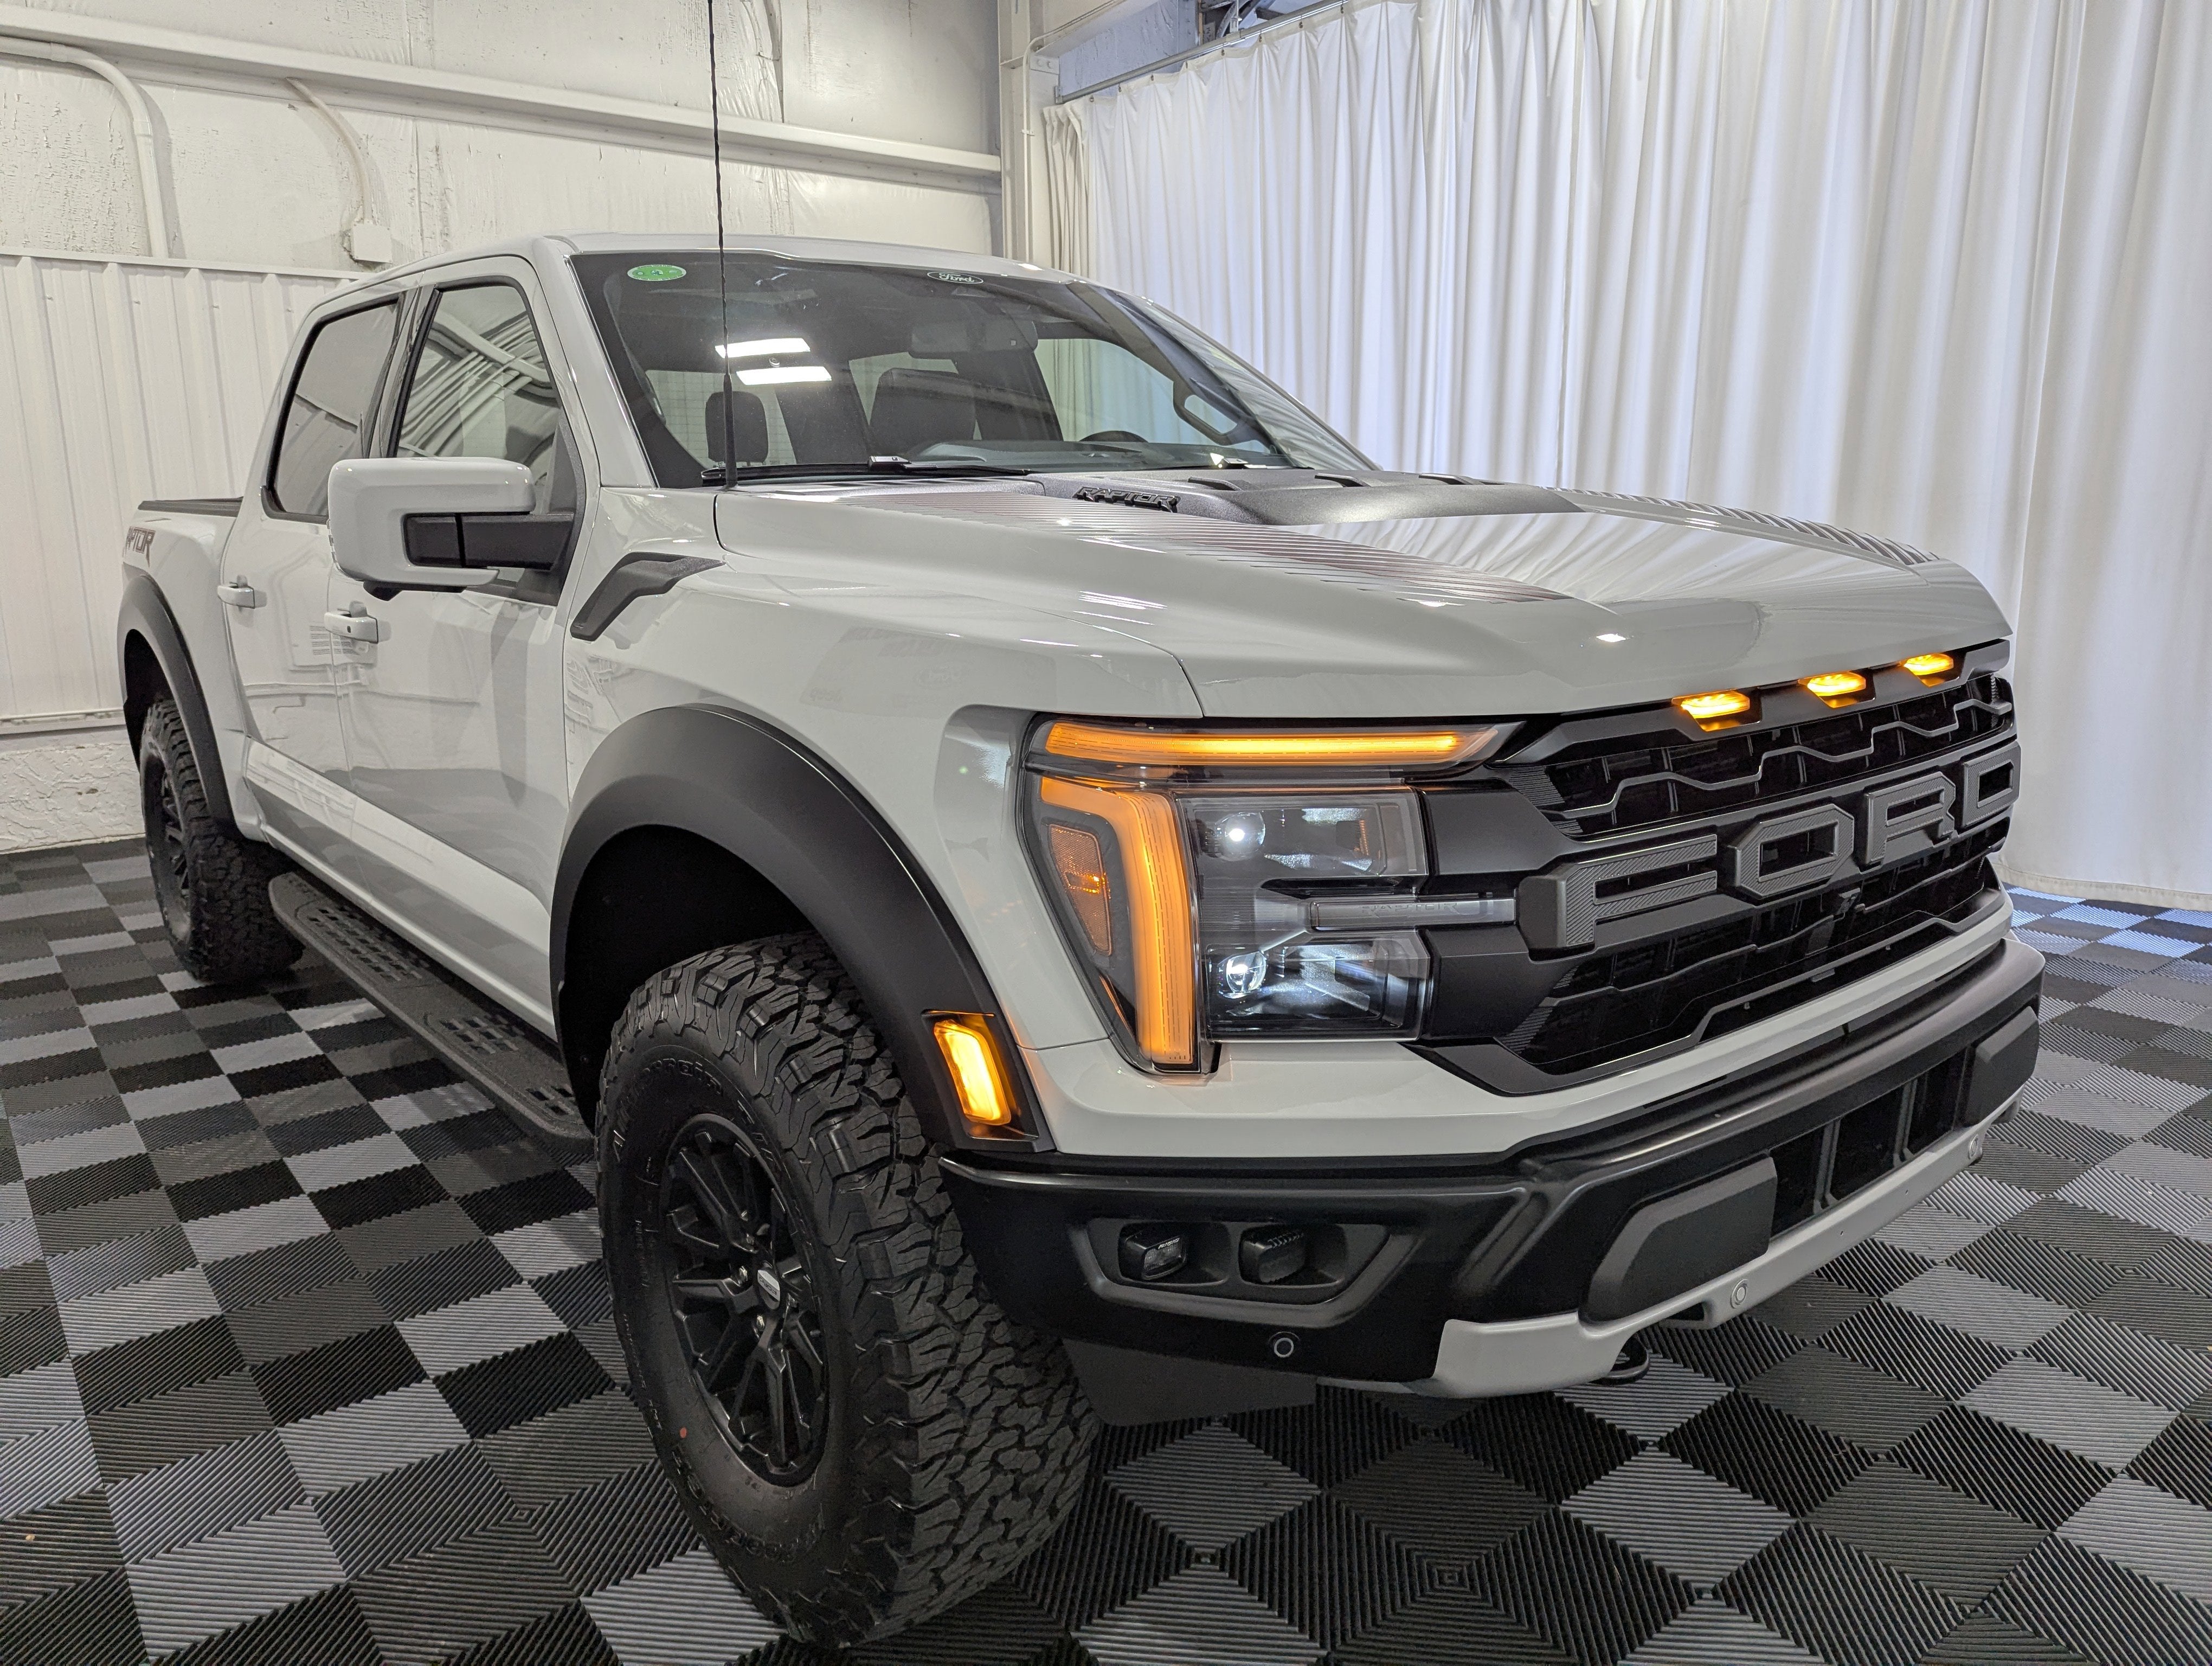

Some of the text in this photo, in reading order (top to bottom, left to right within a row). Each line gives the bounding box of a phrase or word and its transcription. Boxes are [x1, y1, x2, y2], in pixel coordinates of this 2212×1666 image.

[938, 272, 975, 283] Ford
[1072, 486, 1181, 513] RAPTOR
[1555, 741, 2022, 948] FORD
[1361, 902, 1461, 918] RAPTOR
